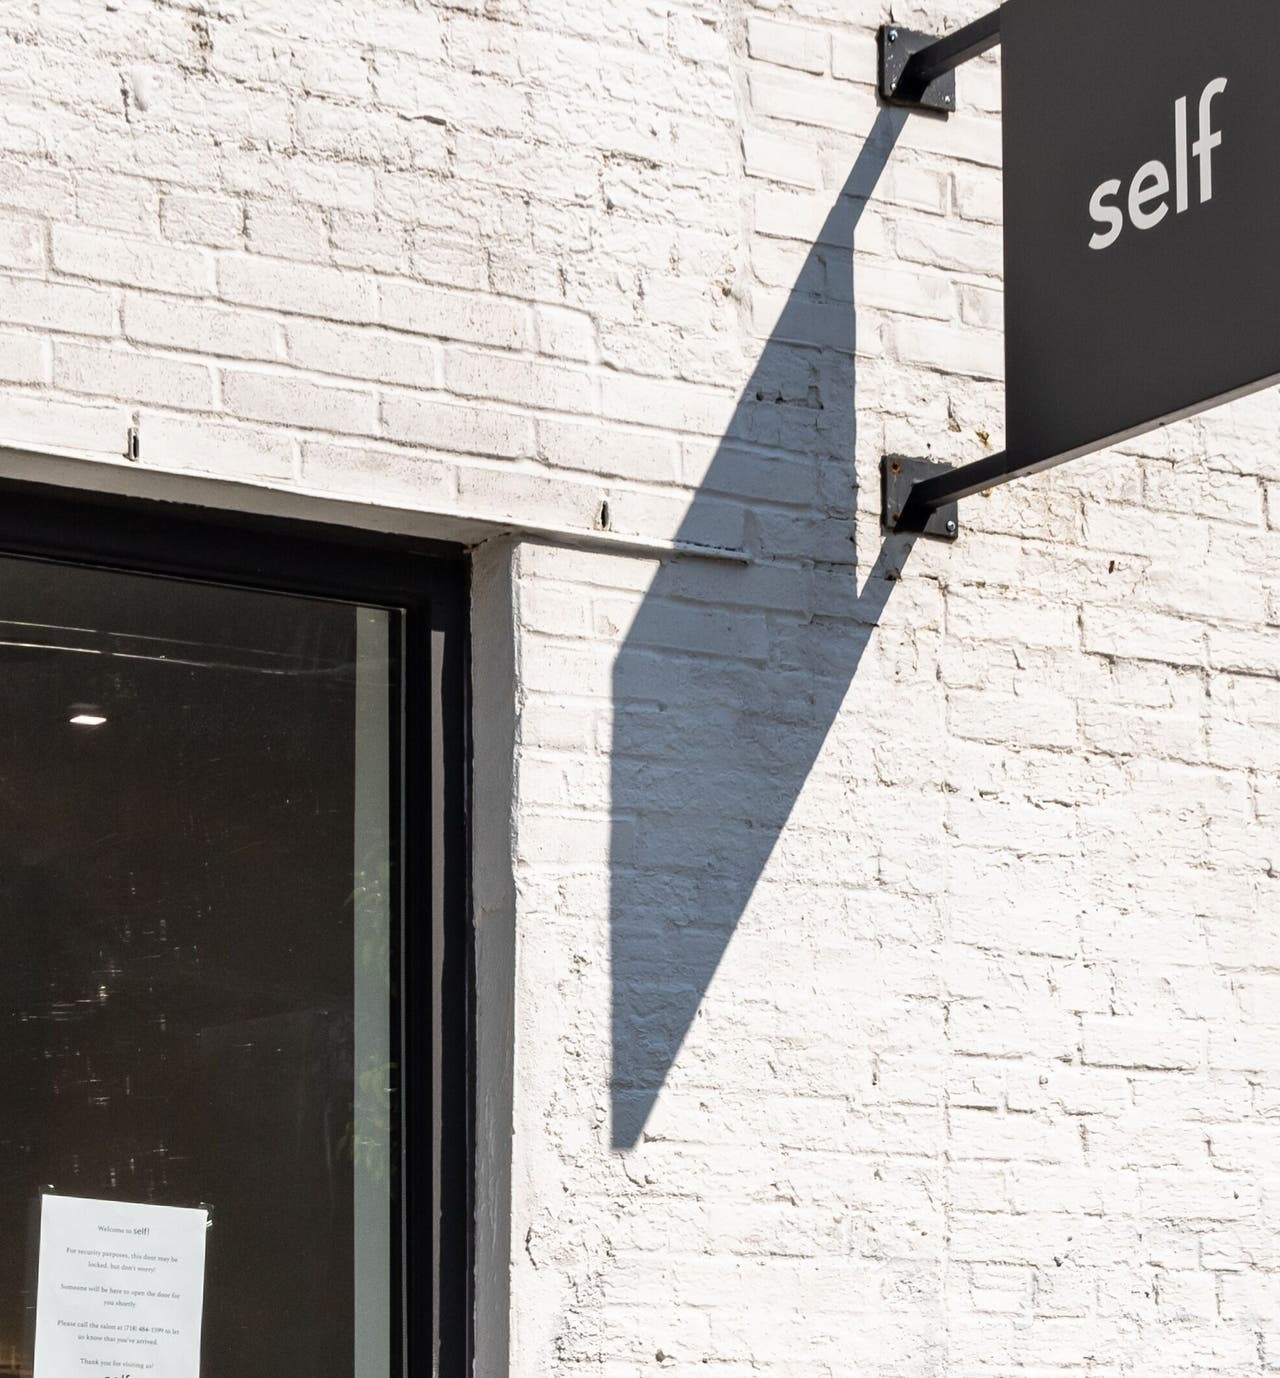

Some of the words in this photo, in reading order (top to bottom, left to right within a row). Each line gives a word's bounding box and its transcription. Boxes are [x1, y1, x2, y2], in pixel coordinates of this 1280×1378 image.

[1088, 76, 1228, 251] self
[97, 1224, 125, 1234] Welcome
[78, 1248, 101, 1257] security
[102, 1251, 130, 1259] purposes,
[131, 1252, 142, 1260] this
[171, 1255, 179, 1263] be
[110, 1262, 120, 1270] but
[121, 1263, 136, 1271] don't
[60, 1283, 88, 1292] Someone
[88, 1285, 100, 1293] will
[109, 1287, 123, 1295] here
[122, 1361, 144, 1369] visiting
